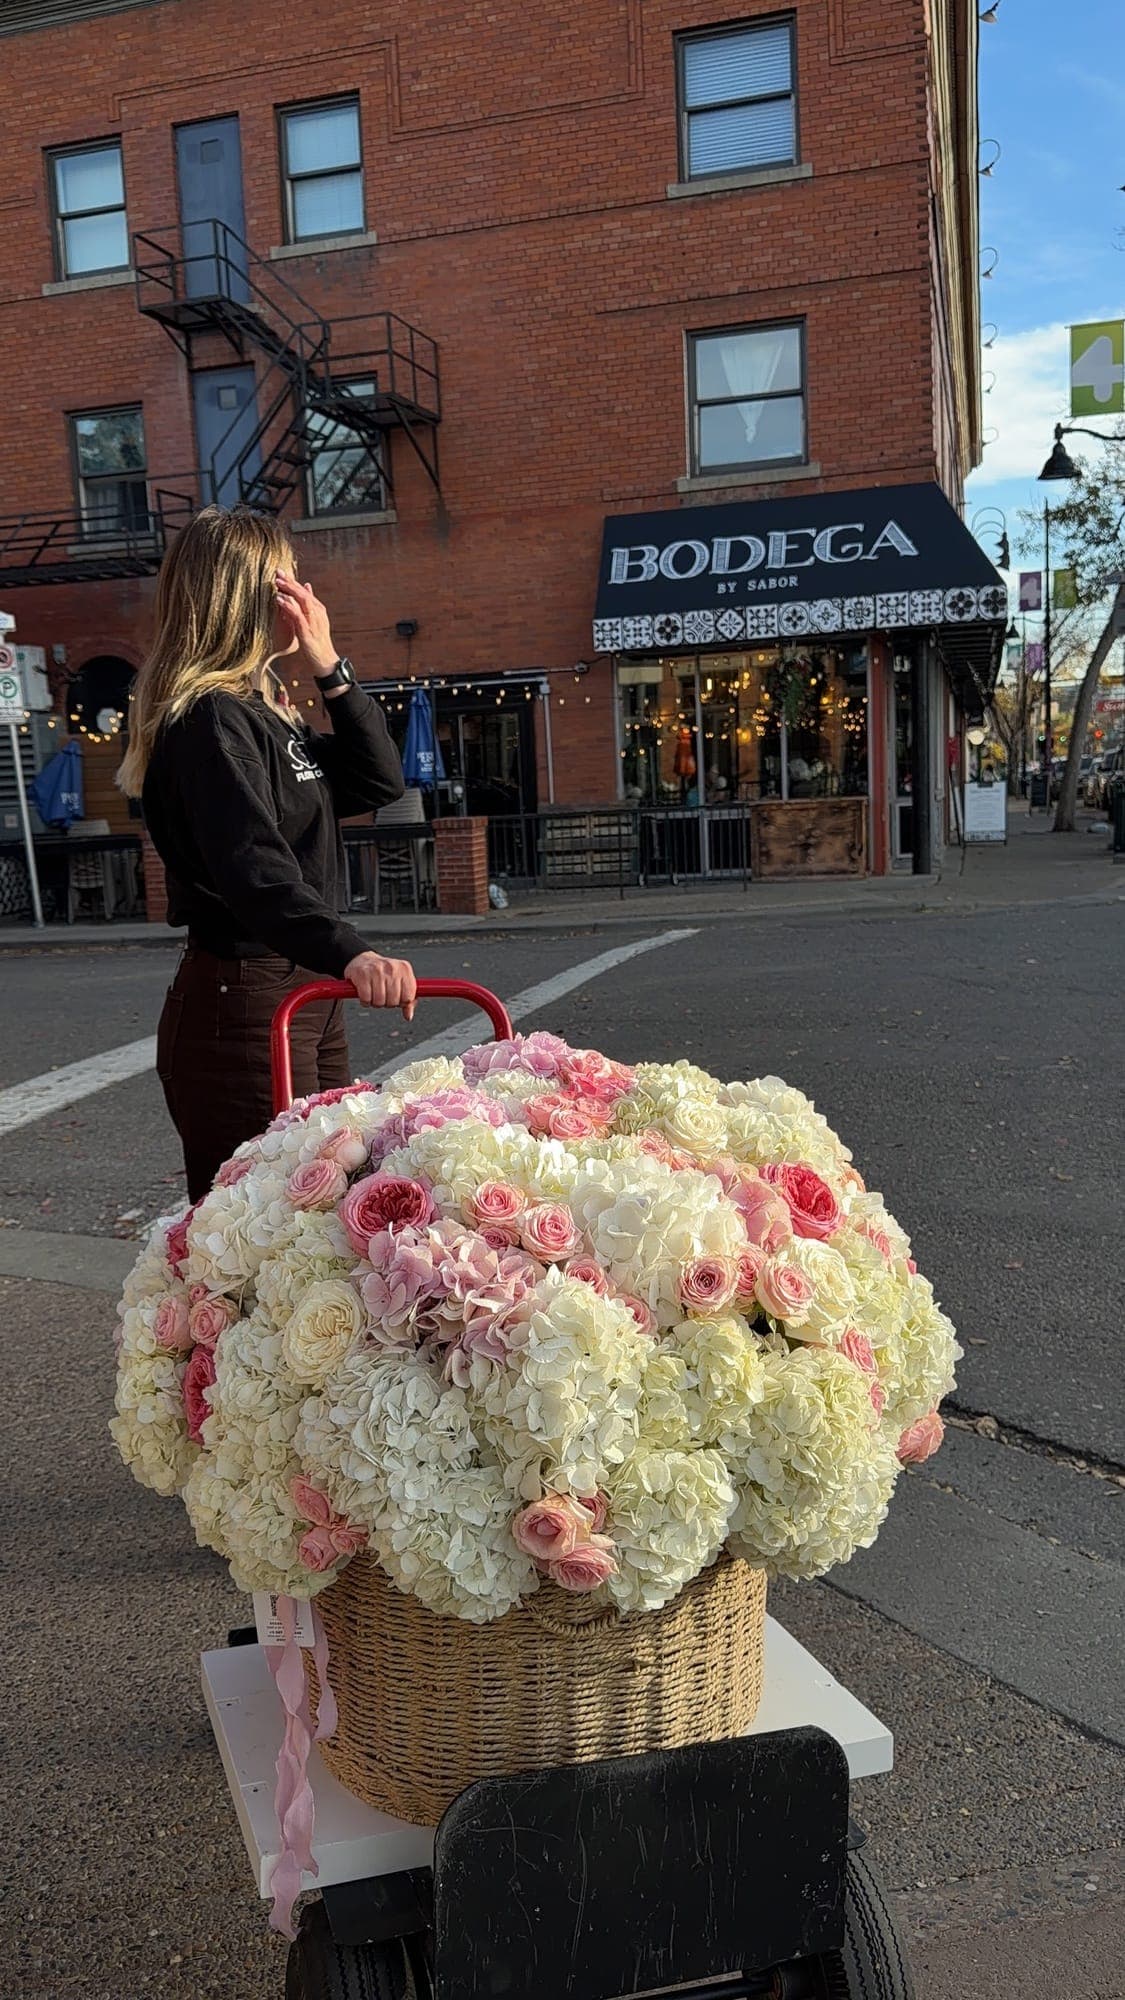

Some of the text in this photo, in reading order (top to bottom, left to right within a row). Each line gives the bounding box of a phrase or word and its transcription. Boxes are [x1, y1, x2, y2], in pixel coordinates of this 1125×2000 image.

[1071, 336, 1124, 402] 4
[607, 519, 919, 585] BODEGA
[717, 575, 799, 594] BY SABOR
